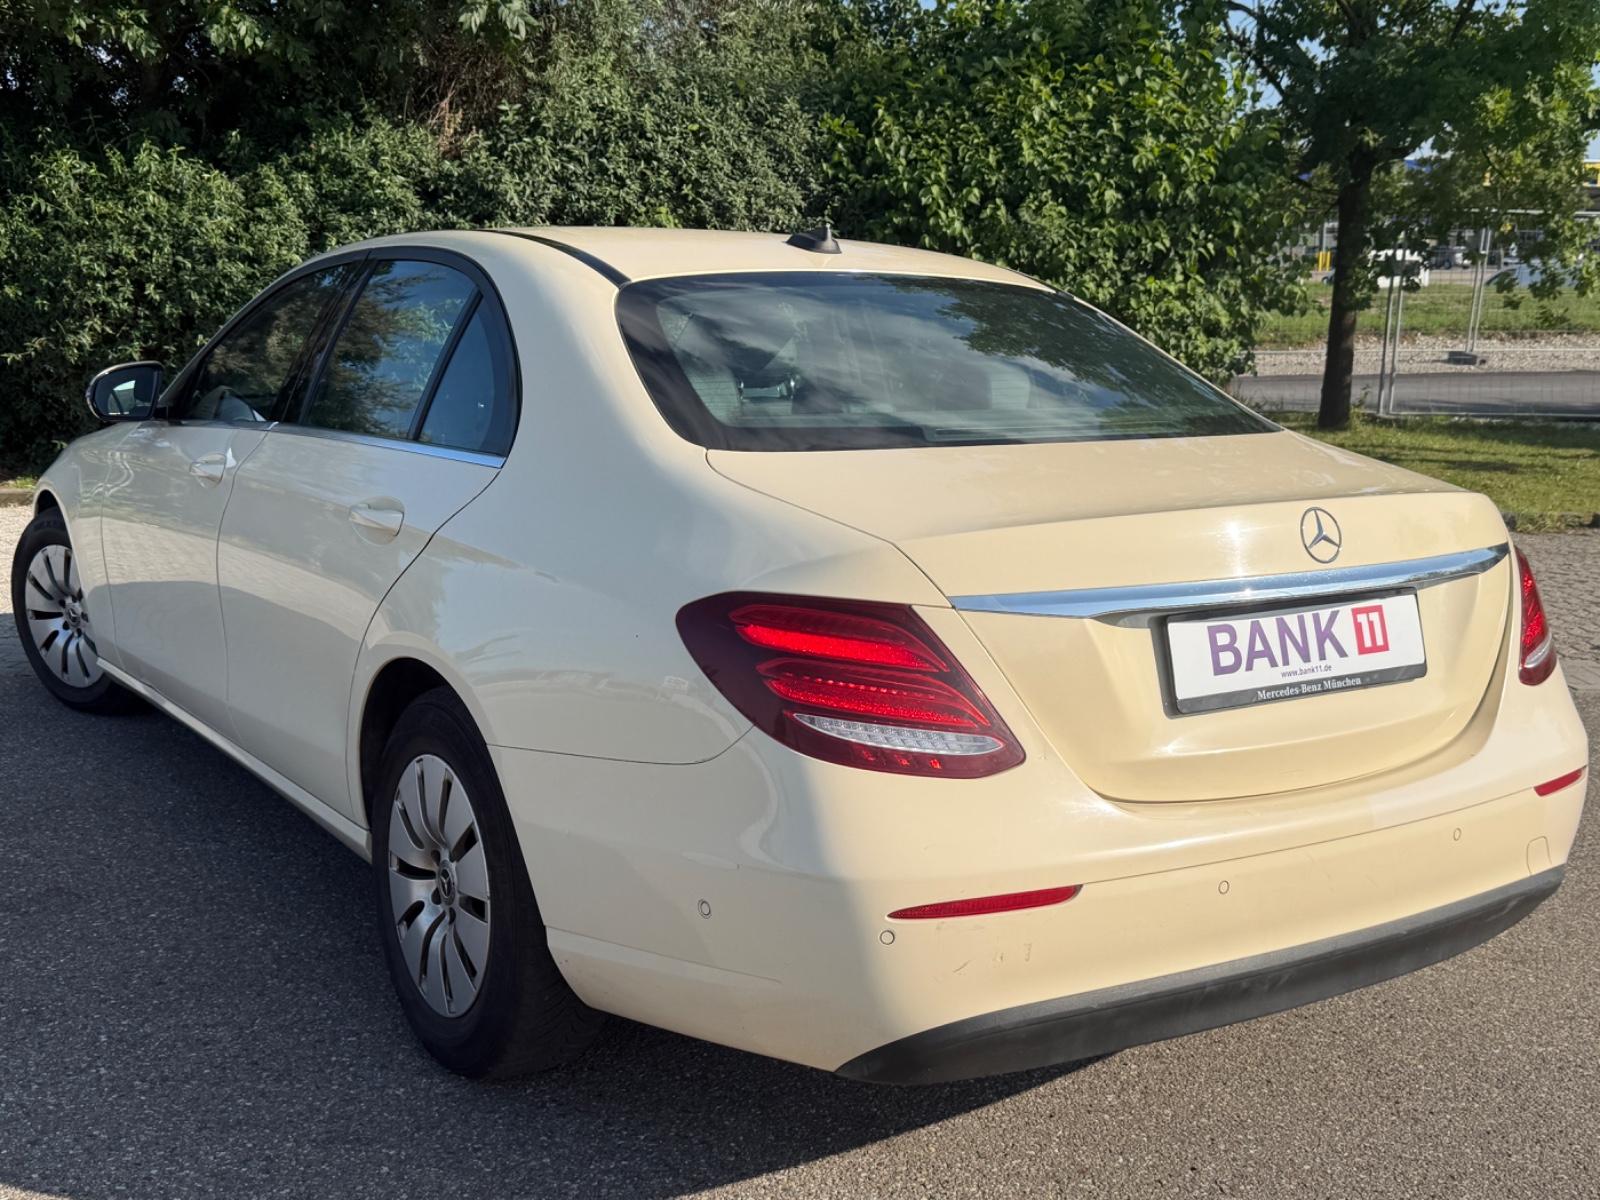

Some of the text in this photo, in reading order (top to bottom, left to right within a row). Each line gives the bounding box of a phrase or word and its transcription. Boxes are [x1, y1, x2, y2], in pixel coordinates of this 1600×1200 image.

[1207, 610, 1384, 676] BANK 11
[1281, 664, 1332, 678] www.bank11.de
[1323, 676, 1361, 690] München
